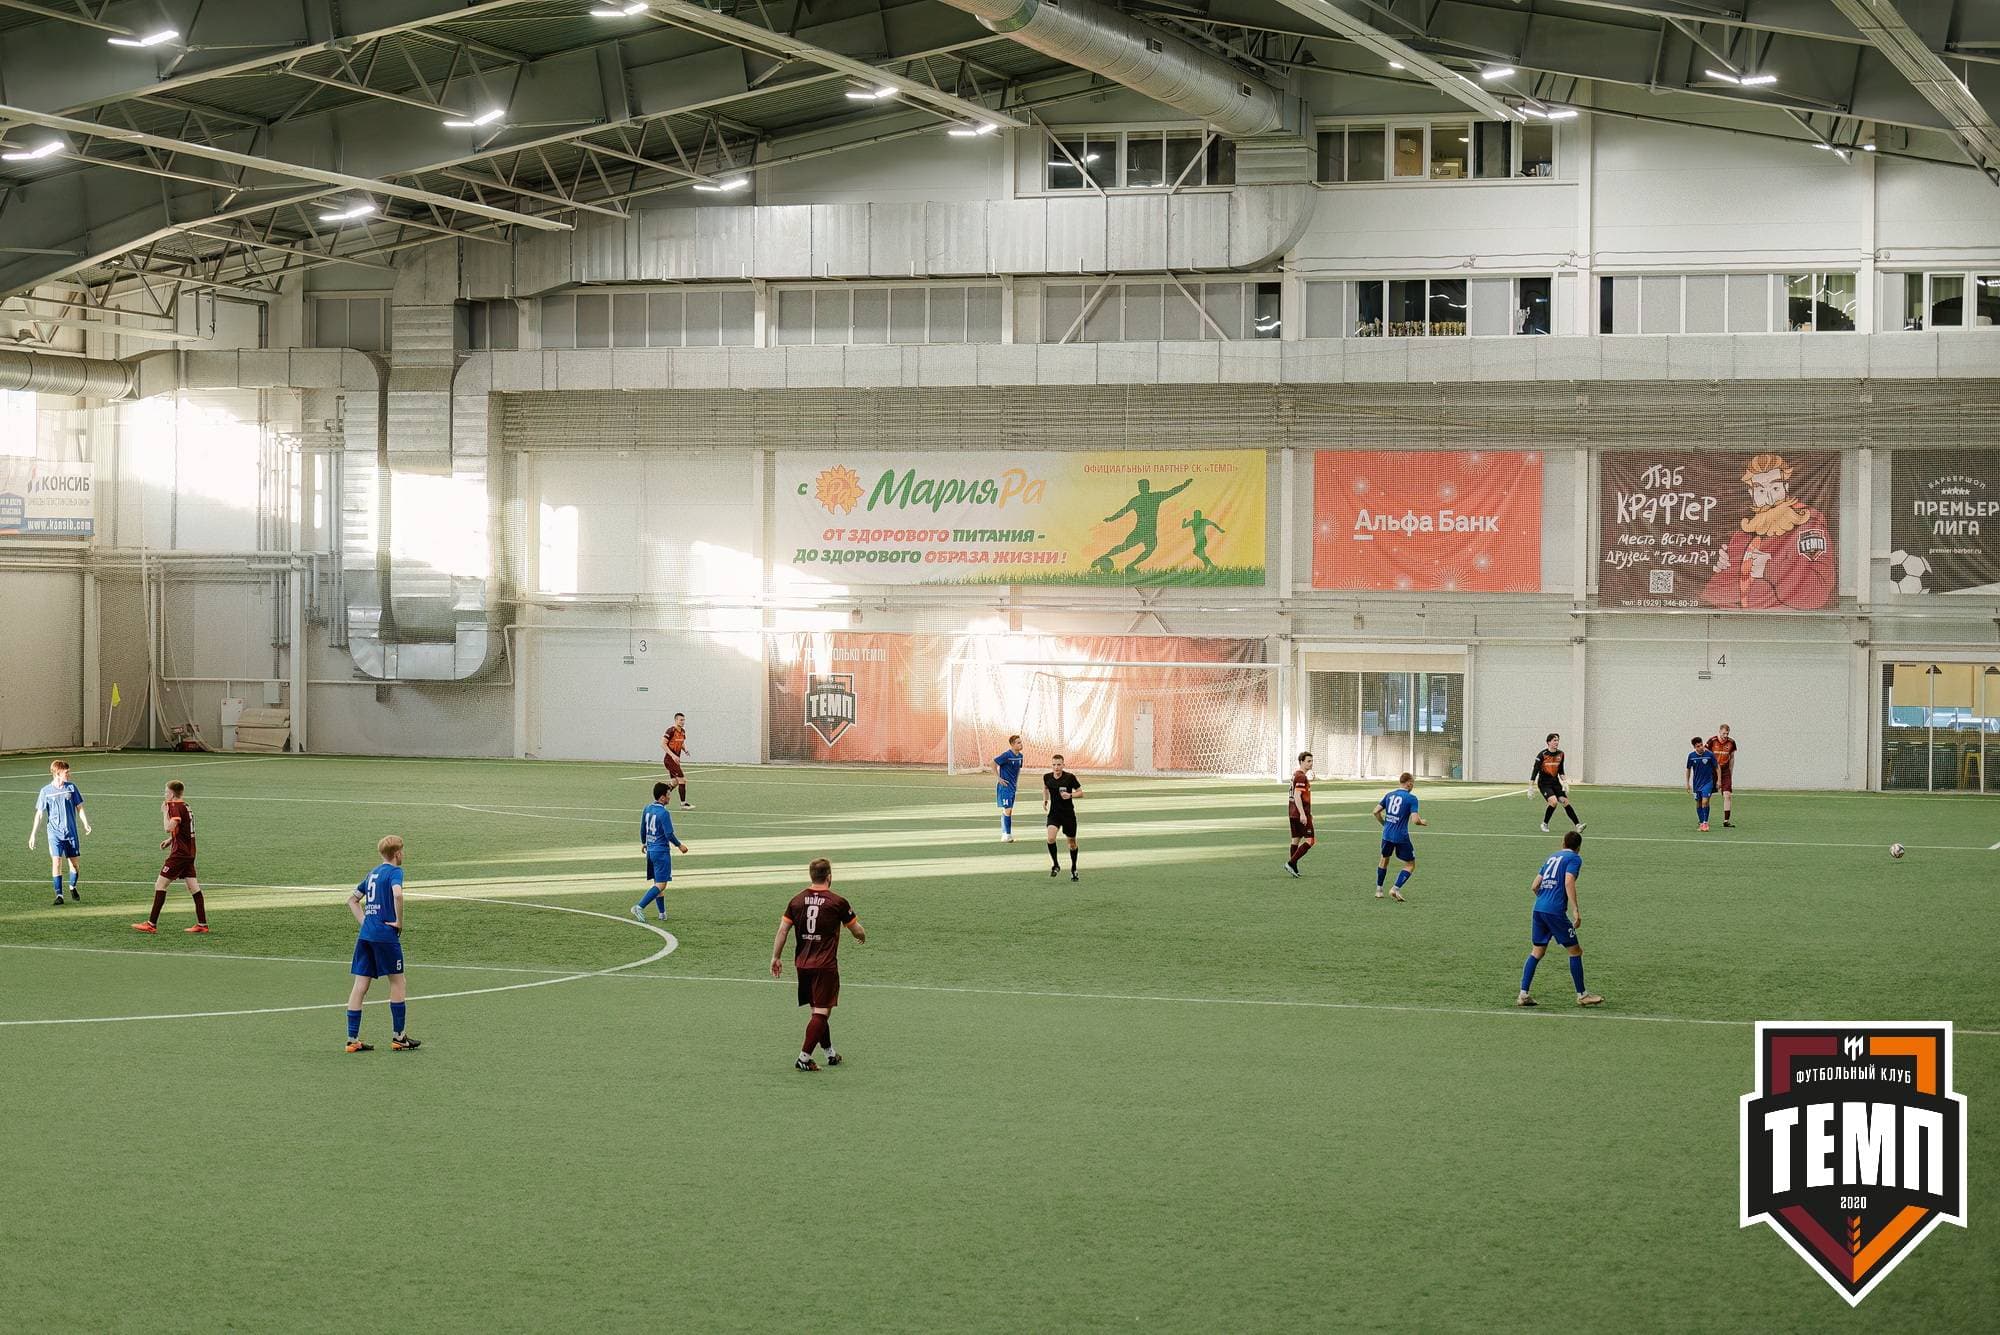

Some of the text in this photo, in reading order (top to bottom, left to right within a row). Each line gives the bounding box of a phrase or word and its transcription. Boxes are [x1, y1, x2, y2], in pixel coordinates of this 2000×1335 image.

[1084, 463, 1151, 474] ОФИЦИАЛЬНЫЙ
[1153, 464, 1189, 473] ПАРТНЕР
[1191, 464, 1201, 473] СК
[42, 475, 90, 492] КОНСИБ
[1640, 464, 1685, 490] Паб
[1928, 475, 1986, 489] БАРБЕРШОП
[1913, 501, 2000, 516] ПРЕМЬЕР
[27, 519, 91, 531] www.konsib.com
[1354, 508, 1500, 537] Альфа Банк
[1933, 520, 1980, 535] ЛИГА
[822, 529, 846, 542] ОТ
[847, 529, 950, 544] ЗДОРОВОГО
[952, 529, 1035, 543] ПИТАНИЯ
[1617, 533, 1711, 547] место встречи
[1800, 537, 1824, 551] ТЕМП
[793, 549, 1067, 564] ДО ЗДОРОВОГО ОБРАЗА ЖИЗНИ!
[639, 639, 648, 653] 3
[829, 648, 859, 661] ОЛЬКО
[1717, 654, 1727, 667] 4
[809, 693, 853, 719] ТЕМП
[1387, 794, 1403, 815] 18
[645, 812, 657, 835] 14
[1543, 855, 1564, 880] 21
[367, 873, 379, 902] 5
[806, 905, 820, 934] 8
[396, 959, 402, 970] 5
